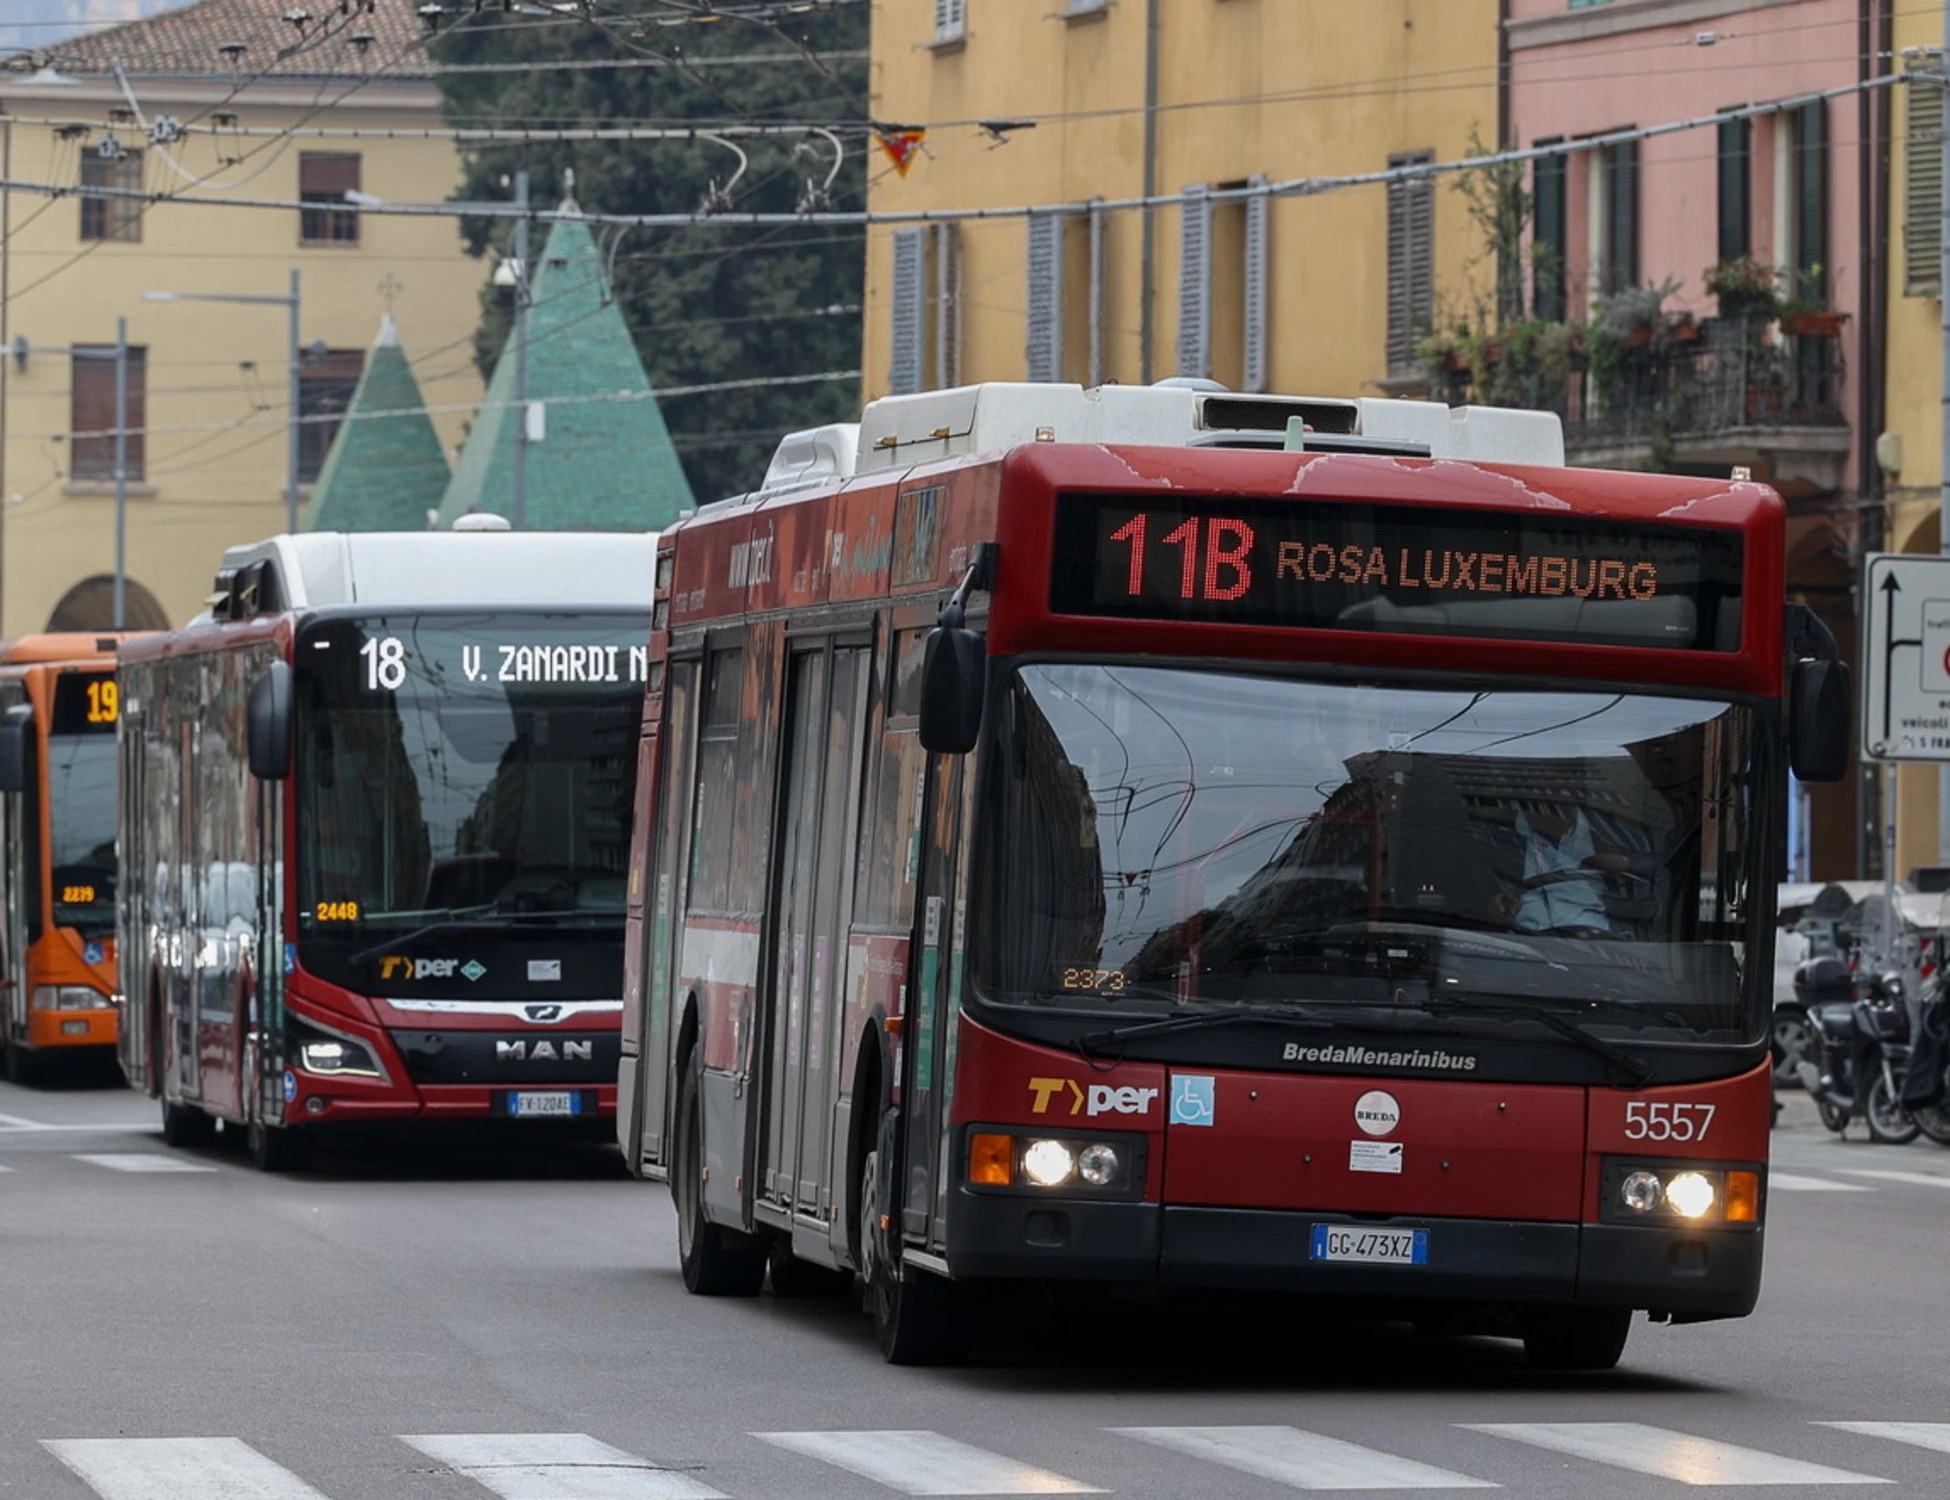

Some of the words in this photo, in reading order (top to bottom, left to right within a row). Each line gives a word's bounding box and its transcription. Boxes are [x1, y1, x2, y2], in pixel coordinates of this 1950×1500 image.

[1108, 513, 1255, 601] 11B
[1277, 541, 1388, 586] ROSA
[1400, 548, 1658, 601] LUXEMBURG
[359, 636, 407, 690] 18
[462, 645, 488, 682] V.
[498, 645, 619, 682] ZANARDI
[629, 645, 648, 682] N
[87, 680, 118, 722] 19
[317, 902, 357, 920] 2448
[1064, 968, 1124, 990] 2373
[496, 1040, 592, 1060] MAN
[1283, 1042, 1477, 1071] BredaMenarinibus
[1357, 1110, 1397, 1122] BREDA
[1624, 1101, 1716, 1141] 5557
